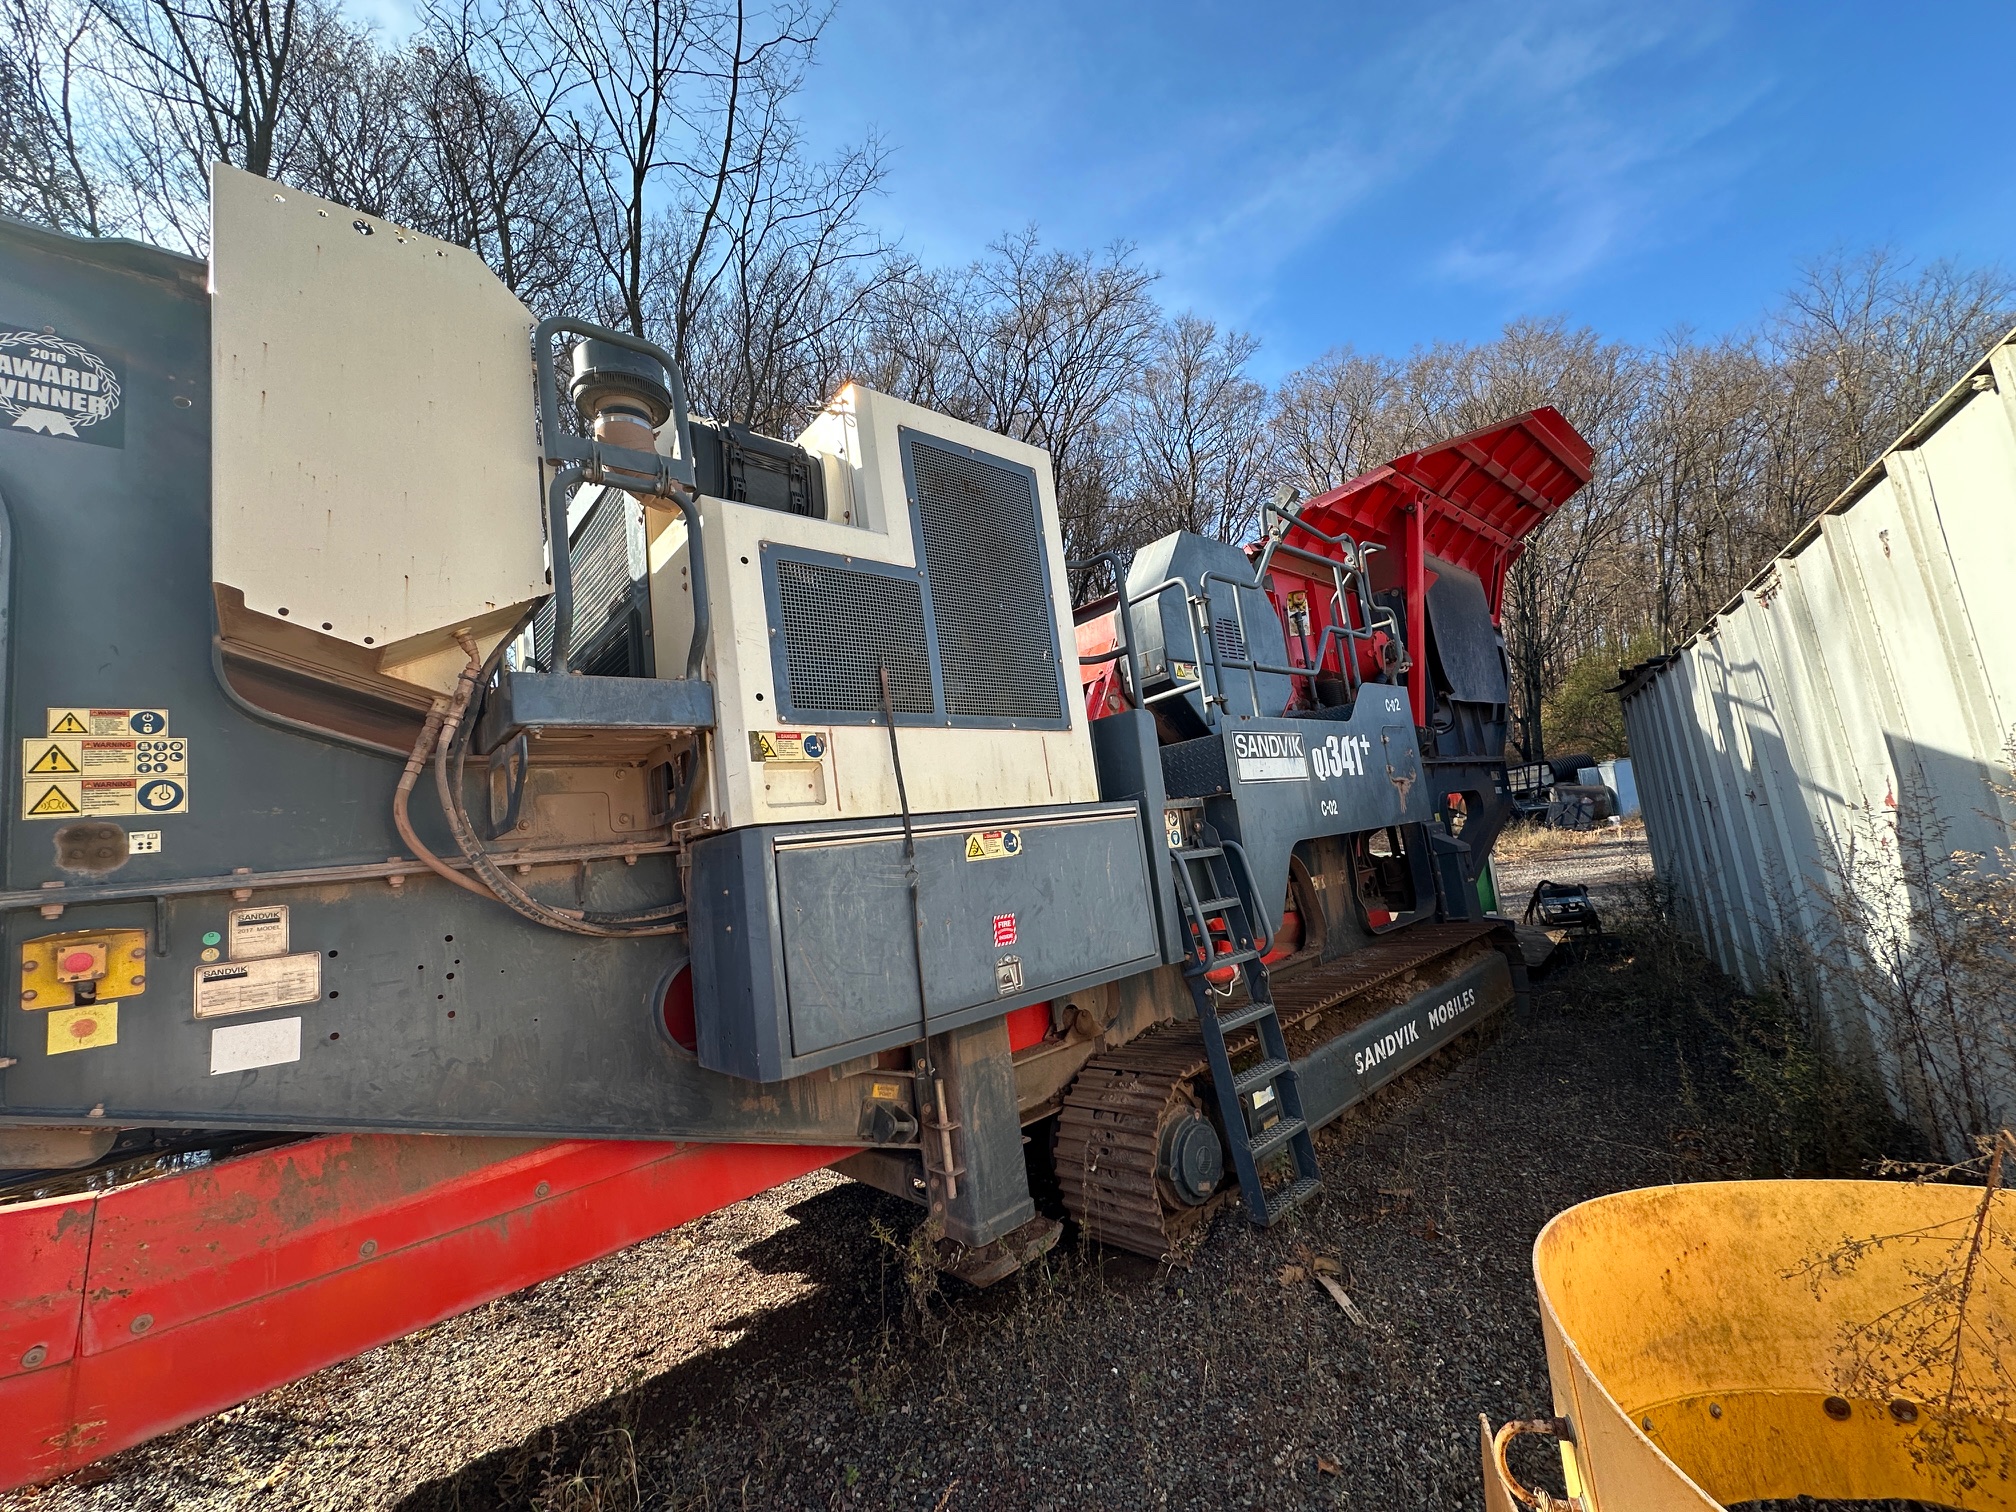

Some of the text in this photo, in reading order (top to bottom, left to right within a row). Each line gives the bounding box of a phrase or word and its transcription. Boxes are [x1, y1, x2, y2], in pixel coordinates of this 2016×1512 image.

[30, 347, 67, 364] 2016
[0, 354, 99, 392] AWARD
[1384, 698, 1402, 712] C-02
[1235, 734, 1304, 758] SANDVIK
[1320, 800, 1339, 816] C-02
[237, 911, 280, 922] SANDVIK
[997, 920, 1012, 928] FIRE
[237, 927, 254, 935] 2017
[203, 965, 248, 978] SANDVIK
[1354, 988, 1476, 1075] SANDVIK MOBILES
